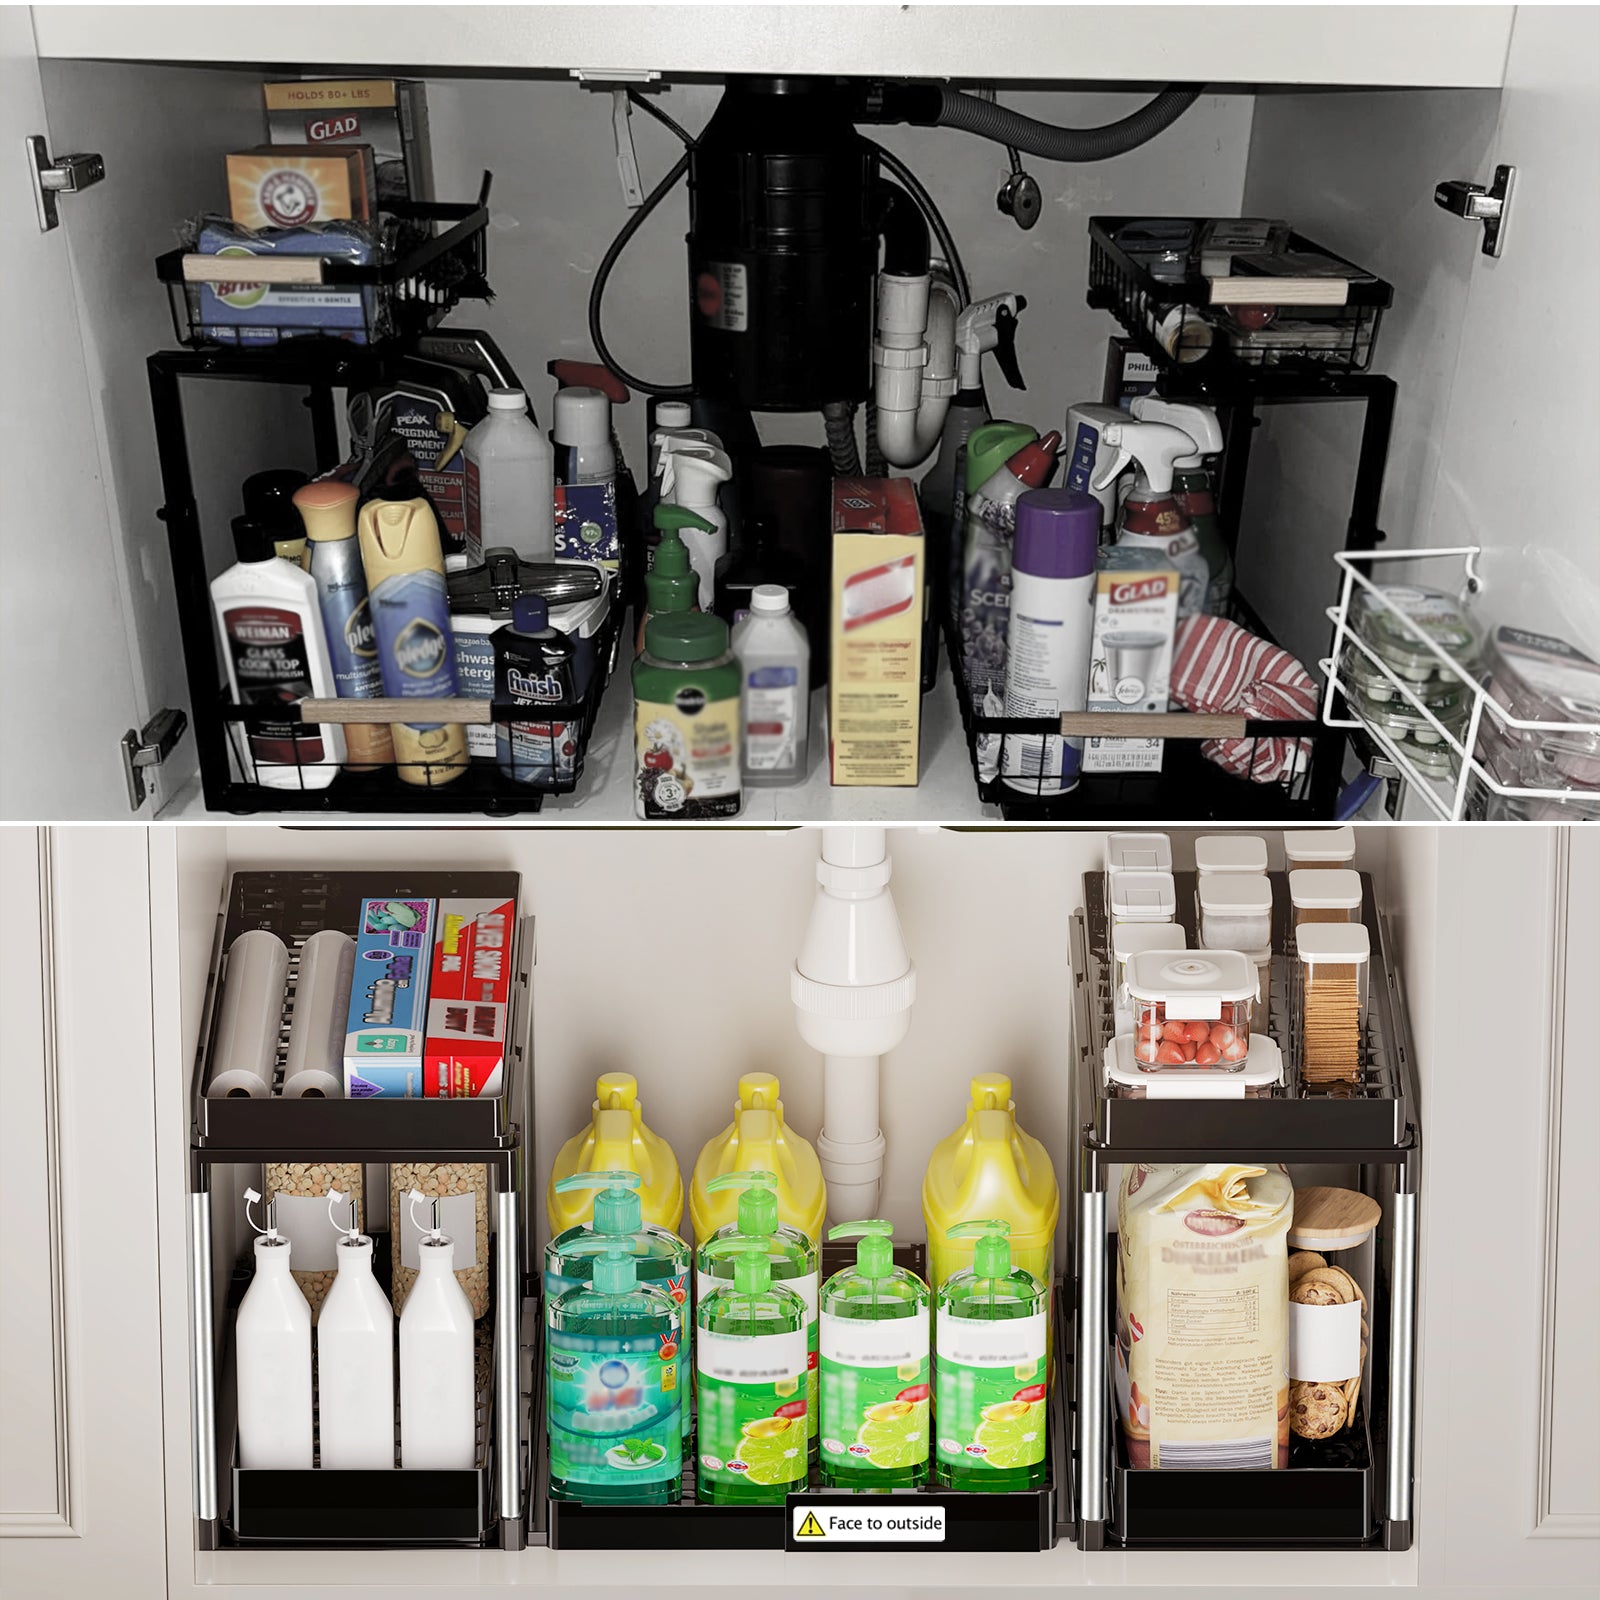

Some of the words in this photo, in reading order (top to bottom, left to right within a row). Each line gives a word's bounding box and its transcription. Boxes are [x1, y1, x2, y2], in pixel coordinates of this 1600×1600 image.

[287, 91, 325, 100] HOLDS
[327, 91, 348, 100] 80+
[351, 89, 371, 99] LBS
[309, 117, 359, 141] GLAD
[396, 415, 431, 426] PEAK
[1113, 580, 1166, 603] GLAD
[1108, 606, 1166, 614] DRAWSTRING
[234, 626, 290, 639] WEIMAN
[347, 624, 376, 654] ple
[246, 648, 286, 660] GLASS
[238, 658, 271, 670] COOK
[275, 659, 300, 670] TOP
[508, 668, 562, 699] finish
